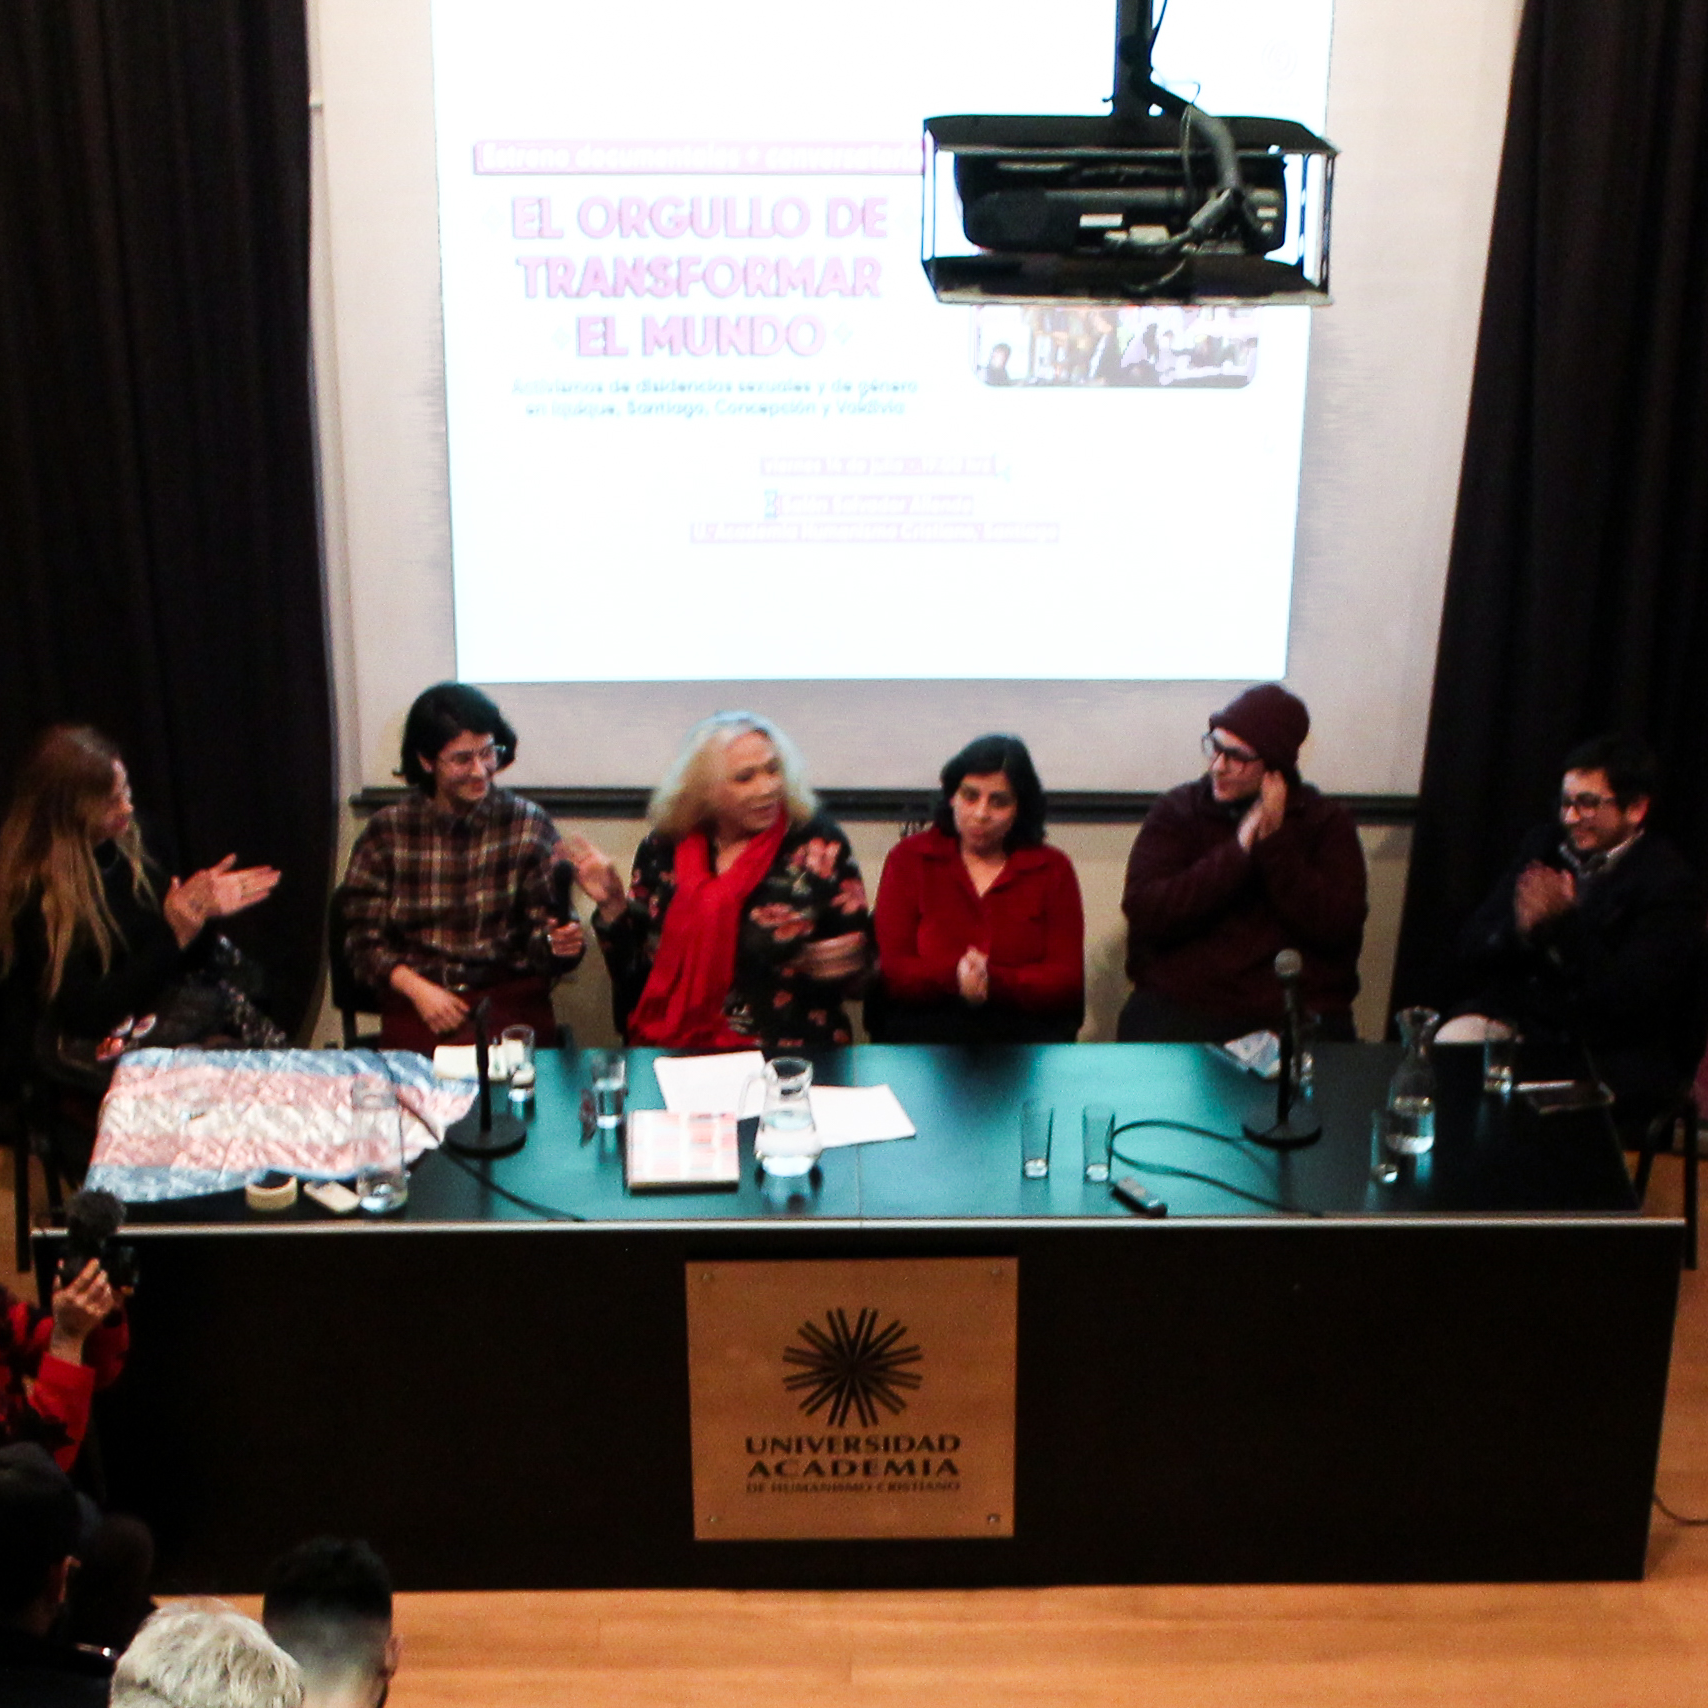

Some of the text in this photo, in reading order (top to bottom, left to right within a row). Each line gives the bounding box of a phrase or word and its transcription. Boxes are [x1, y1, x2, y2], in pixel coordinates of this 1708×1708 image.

[574, 141, 741, 169] documentales
[512, 196, 889, 239] EL ORGULLO DE
[516, 255, 882, 298] TRANSFORMAR
[577, 314, 826, 356] EL MUNDO
[738, 378, 812, 394] sexuales
[818, 382, 827, 397] y
[831, 378, 853, 394] de
[745, 1434, 961, 1455] UNIVERSIDAD
[747, 1459, 959, 1477] ACADEMIA
